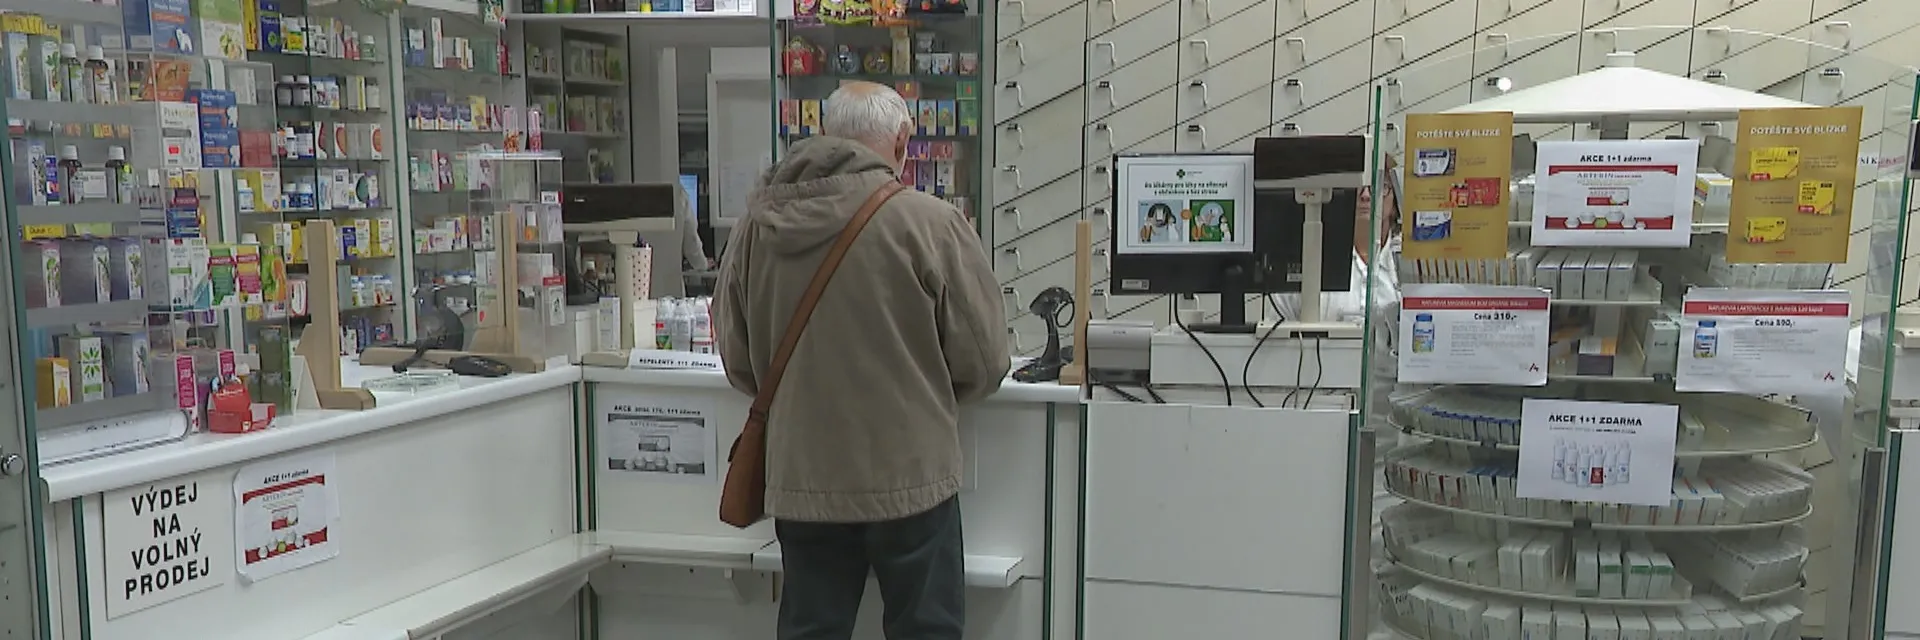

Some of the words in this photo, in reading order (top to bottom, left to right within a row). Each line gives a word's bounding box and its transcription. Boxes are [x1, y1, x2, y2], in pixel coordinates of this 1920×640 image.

[1417, 129, 1453, 139] POTĚŠTE
[1455, 128, 1470, 138] SVÉ
[1472, 127, 1501, 137] BLÍZKÉ
[1751, 124, 1793, 135] POTĚŠTE
[1794, 124, 1812, 134] SVÉ
[1814, 124, 1847, 134] BLÍZKÉ
[1494, 312, 1517, 321] 310,-
[1549, 414, 1577, 423] AKCE
[1580, 415, 1596, 424] 1+1
[1599, 416, 1642, 427] ZDARMA
[263, 474, 279, 484] AKCE
[131, 482, 197, 516] VÝDEJ
[153, 513, 181, 538] NA
[131, 527, 201, 570] VOLNÝ
[125, 557, 209, 600] PRODEJ
